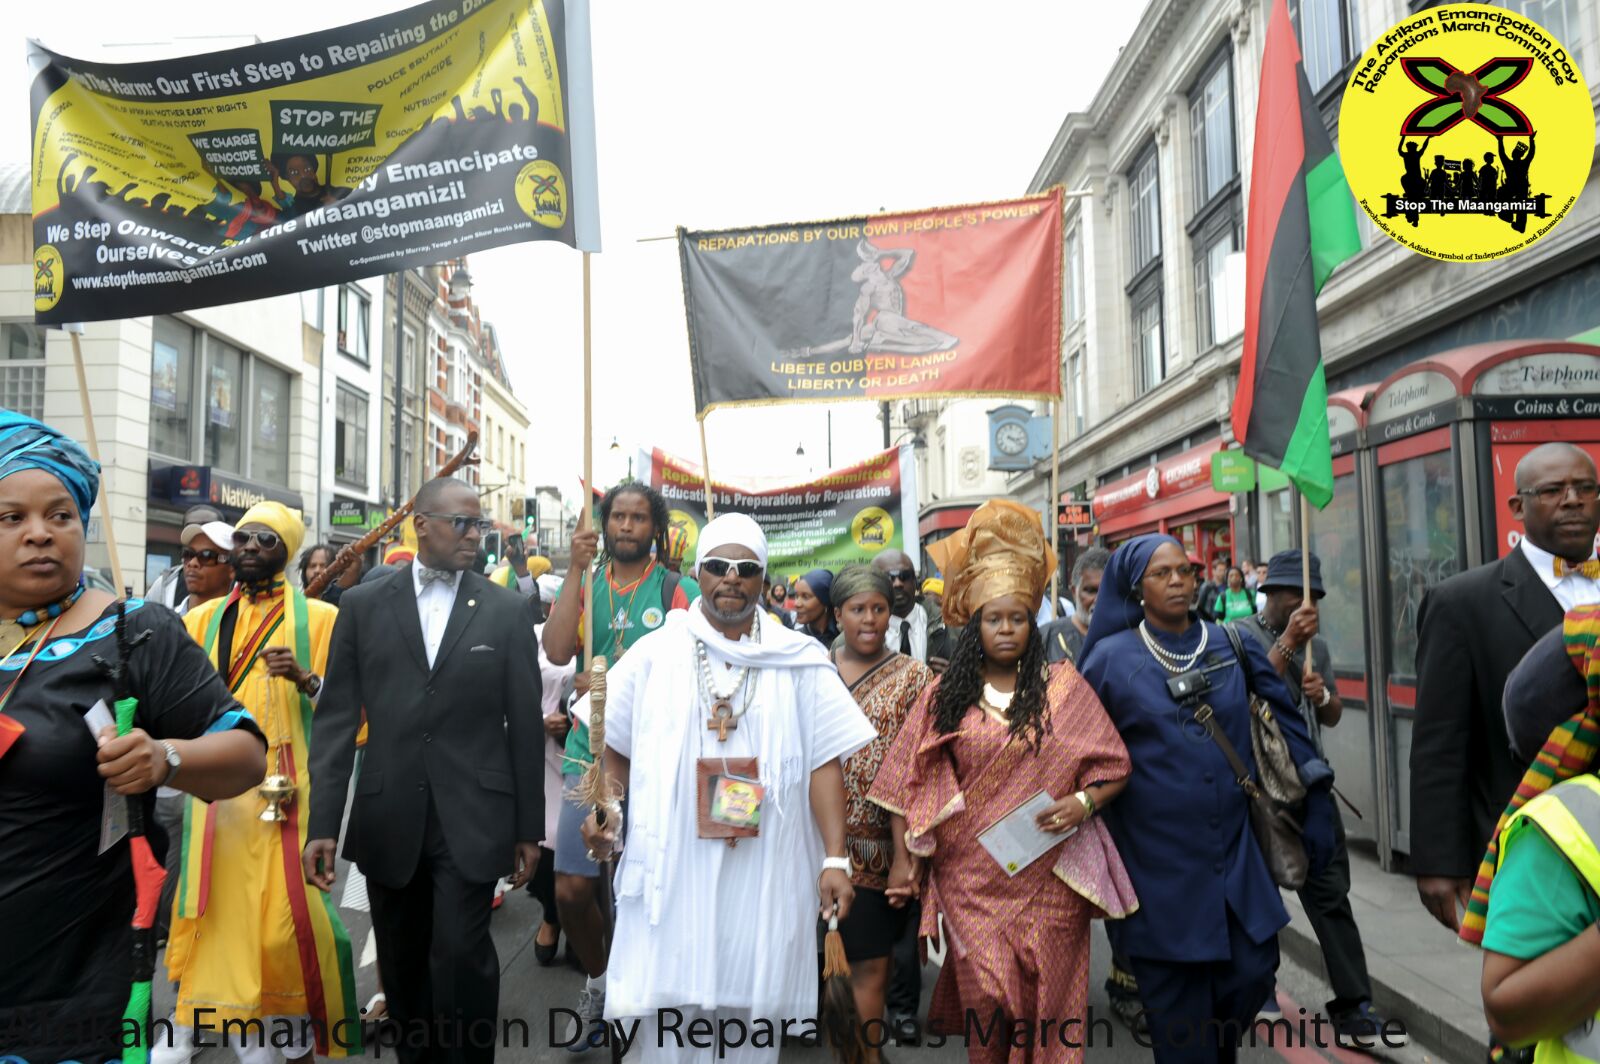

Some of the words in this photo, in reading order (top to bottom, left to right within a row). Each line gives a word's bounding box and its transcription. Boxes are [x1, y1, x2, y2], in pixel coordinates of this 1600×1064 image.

[107, 77, 157, 96] Harm:
[156, 77, 190, 96] Our
[192, 67, 242, 92] First
[243, 60, 296, 84] Step
[299, 52, 324, 72] to
[326, 25, 426, 66] Repairing
[430, 10, 458, 32] the
[367, 67, 407, 93] POLICE
[399, 56, 453, 98] MENTACIDE
[216, 101, 248, 113] RIGHTS
[279, 107, 334, 127] STOP
[339, 109, 377, 127] THE
[191, 138, 210, 149] WE
[212, 133, 257, 149] CHARGE
[282, 129, 372, 148] MAANGAMIZI
[205, 150, 257, 163] GENOCIDE
[218, 164, 262, 176] ECOCIDE
[47, 225, 69, 243] We
[74, 220, 111, 241] Step
[386, 144, 538, 183] Emancipate
[96, 243, 199, 265] Ourselves
[304, 180, 467, 229] Maangamizi!
[297, 230, 358, 256] Twitter
[361, 199, 505, 243] @stopmaangamizi
[698, 232, 799, 251] REPARATIONS
[804, 230, 823, 243] BY
[827, 226, 860, 241] OUR
[863, 222, 899, 236] OWN
[903, 212, 977, 233] PEOPLE'S
[981, 204, 1041, 223] POWER
[72, 251, 267, 290] www.stopthemaangamizi.com
[771, 362, 826, 375] LIBETE
[830, 357, 896, 374] OUBYEN
[901, 351, 957, 370] LANMO
[788, 378, 855, 390] LIBERTY
[859, 376, 881, 389] OR
[887, 368, 939, 388] DEATH
[1514, 399, 1553, 415] Coins
[1556, 399, 1570, 415] &
[1573, 398, 1600, 414] Car
[1385, 424, 1405, 439] Coins
[1405, 421, 1412, 433] &
[1413, 411, 1436, 430] Cards
[661, 484, 718, 503] Educatin
[721, 492, 731, 505] is
[734, 492, 802, 509] Preparation
[805, 491, 821, 504] for
[824, 485, 892, 505] Reparations
